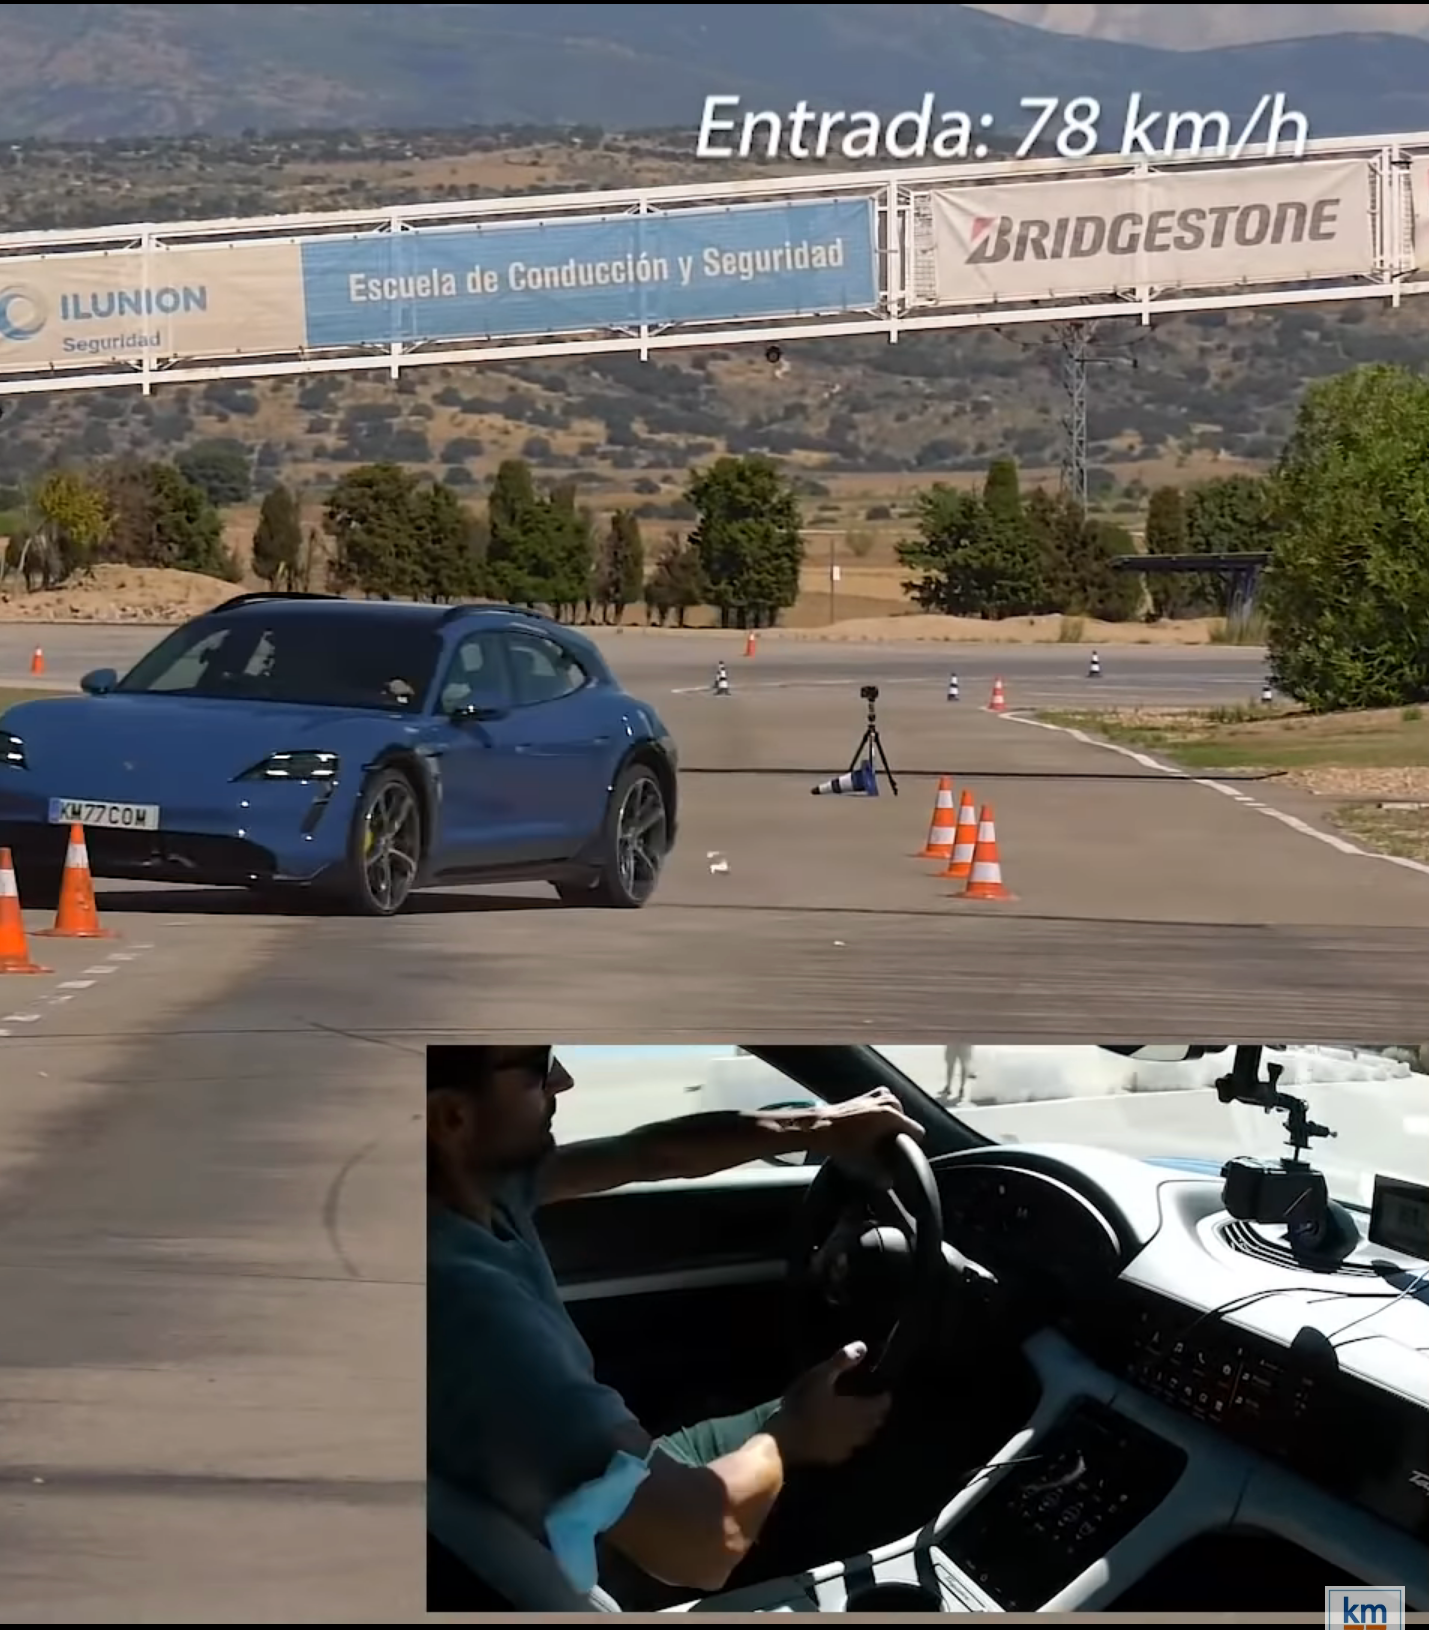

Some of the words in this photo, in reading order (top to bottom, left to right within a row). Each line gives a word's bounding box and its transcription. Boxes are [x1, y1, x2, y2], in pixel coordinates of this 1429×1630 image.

[964, 198, 1341, 265] BRIDGESTONE
[349, 267, 457, 302] Escuela
[466, 264, 499, 294] de
[508, 251, 669, 292] Conducción
[678, 255, 693, 286] y
[703, 238, 845, 281] Seguridad
[60, 285, 208, 320] ILUNION
[63, 330, 161, 354] Seguridad
